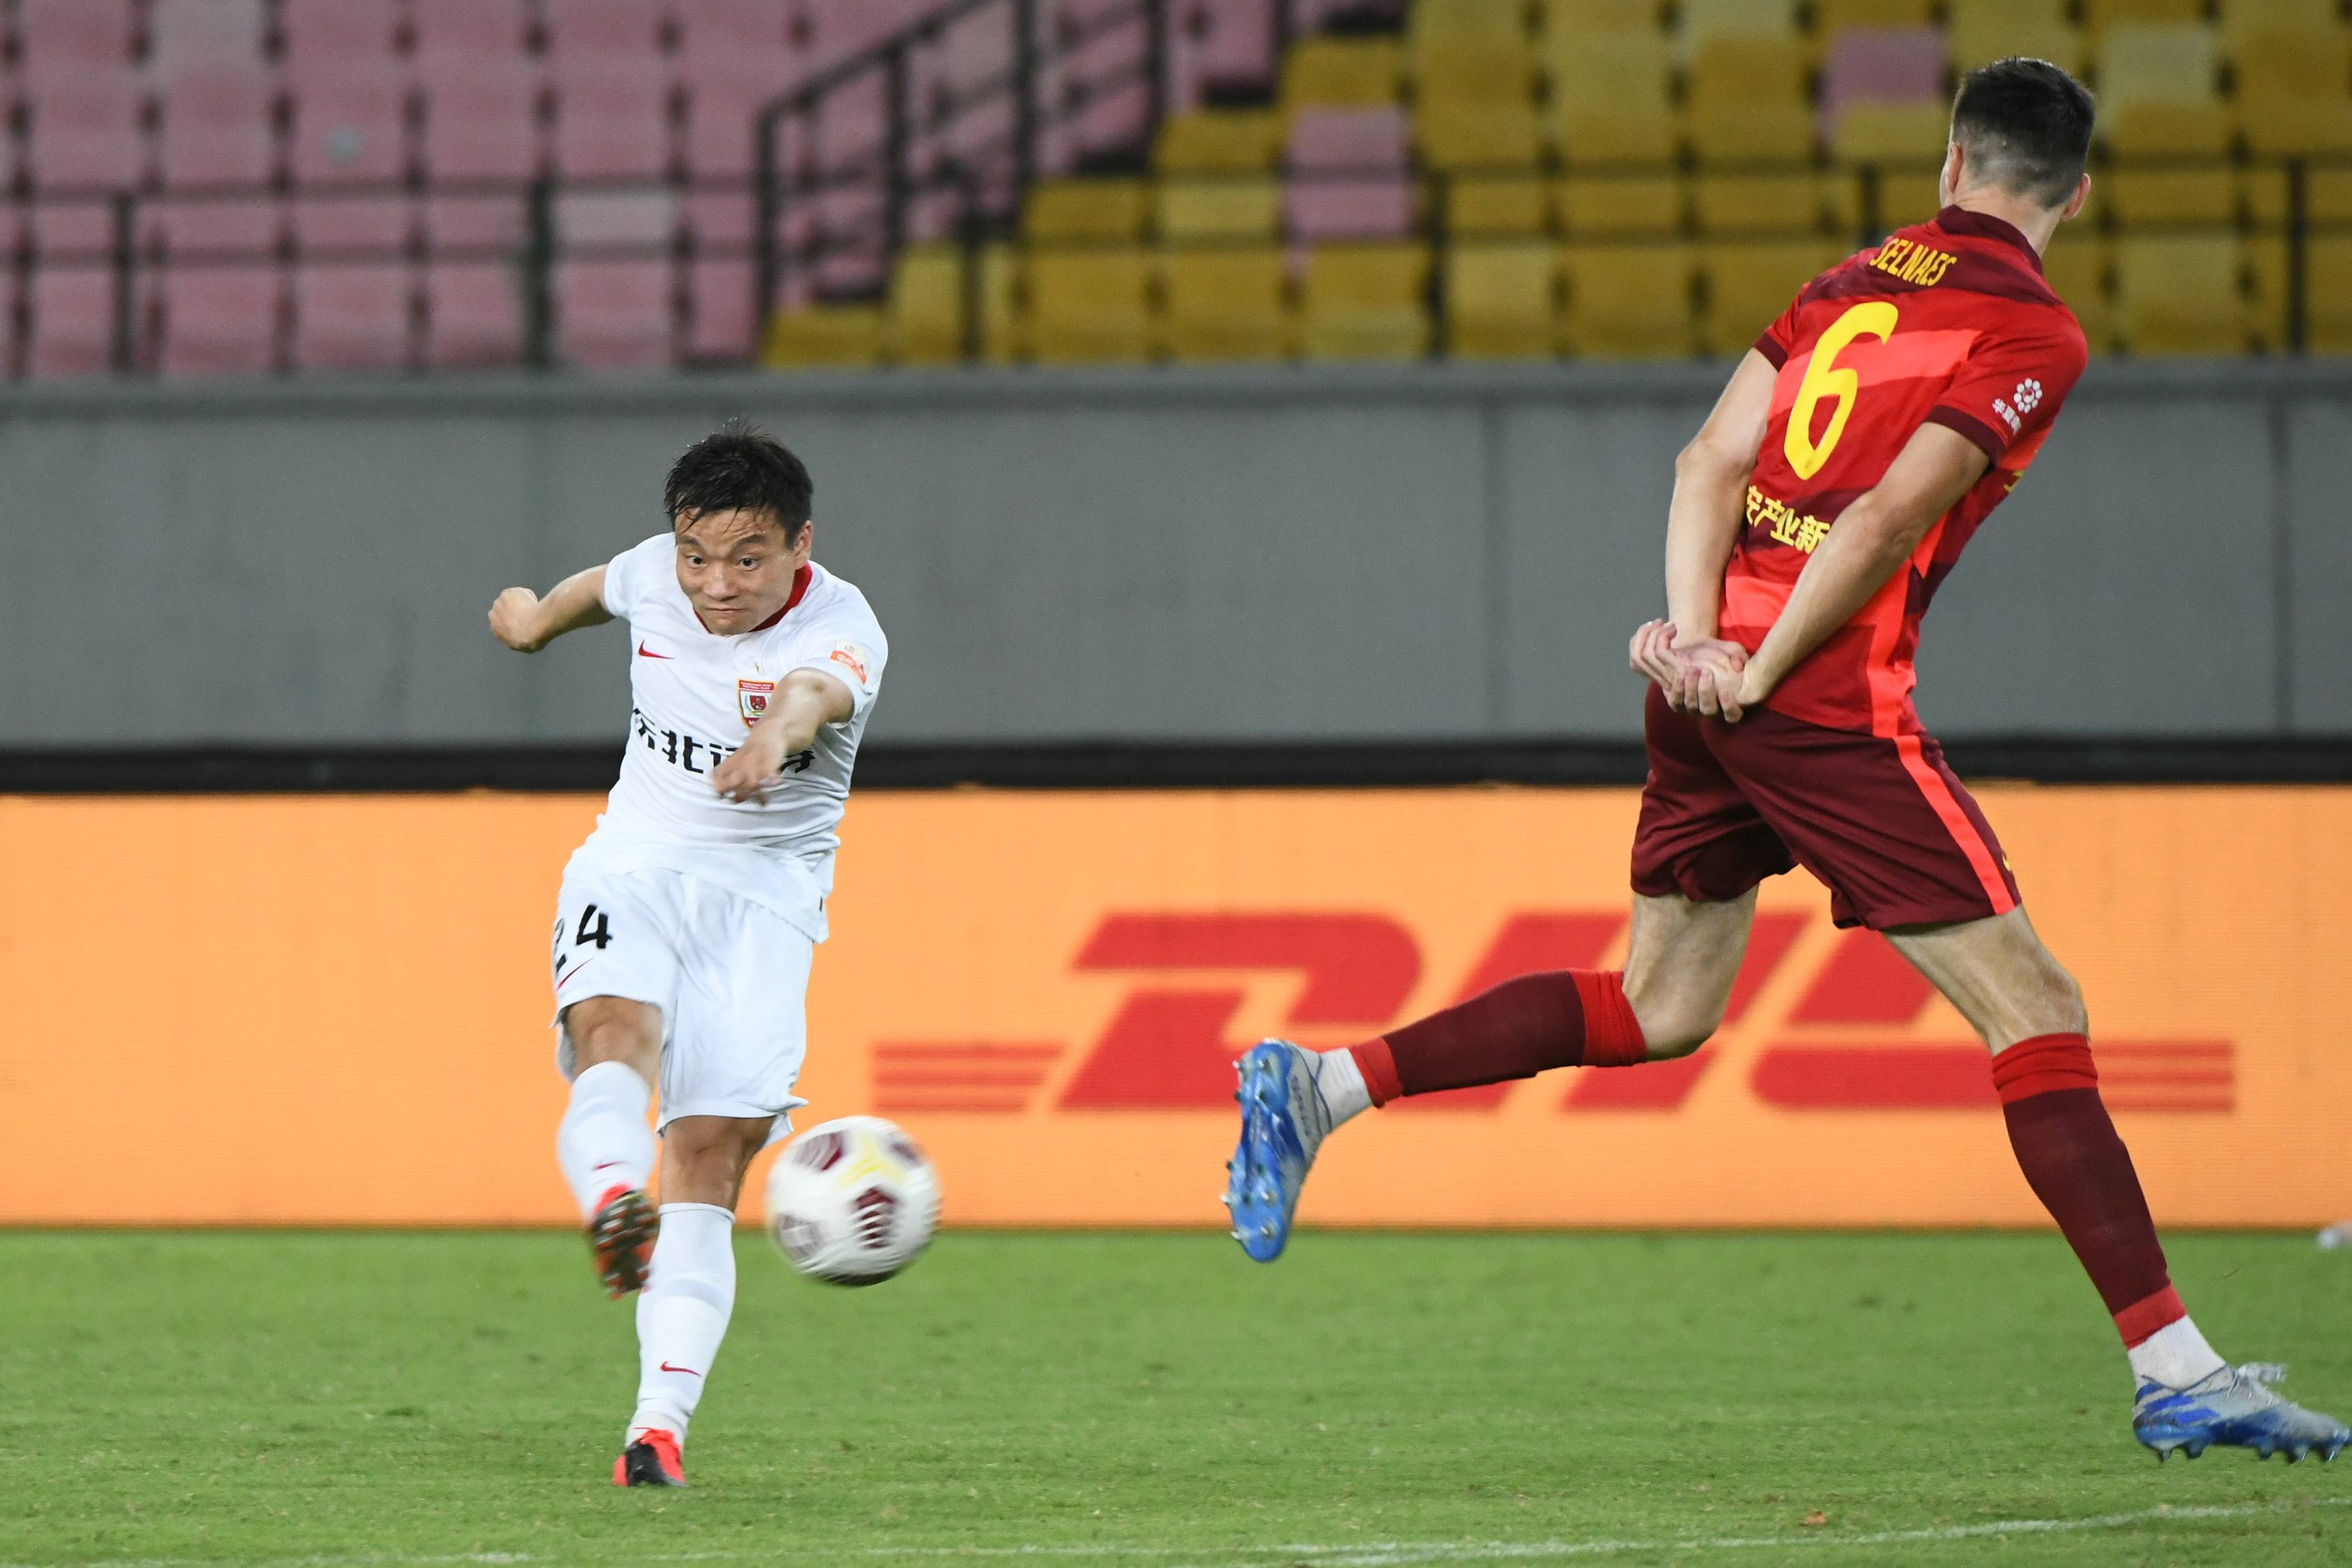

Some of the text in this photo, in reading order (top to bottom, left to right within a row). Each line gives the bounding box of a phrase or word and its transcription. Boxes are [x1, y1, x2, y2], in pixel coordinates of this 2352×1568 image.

[1870, 238, 1957, 287] SELNAES
[1783, 301, 1899, 481] 6
[1055, 912, 2041, 1112] DHL
